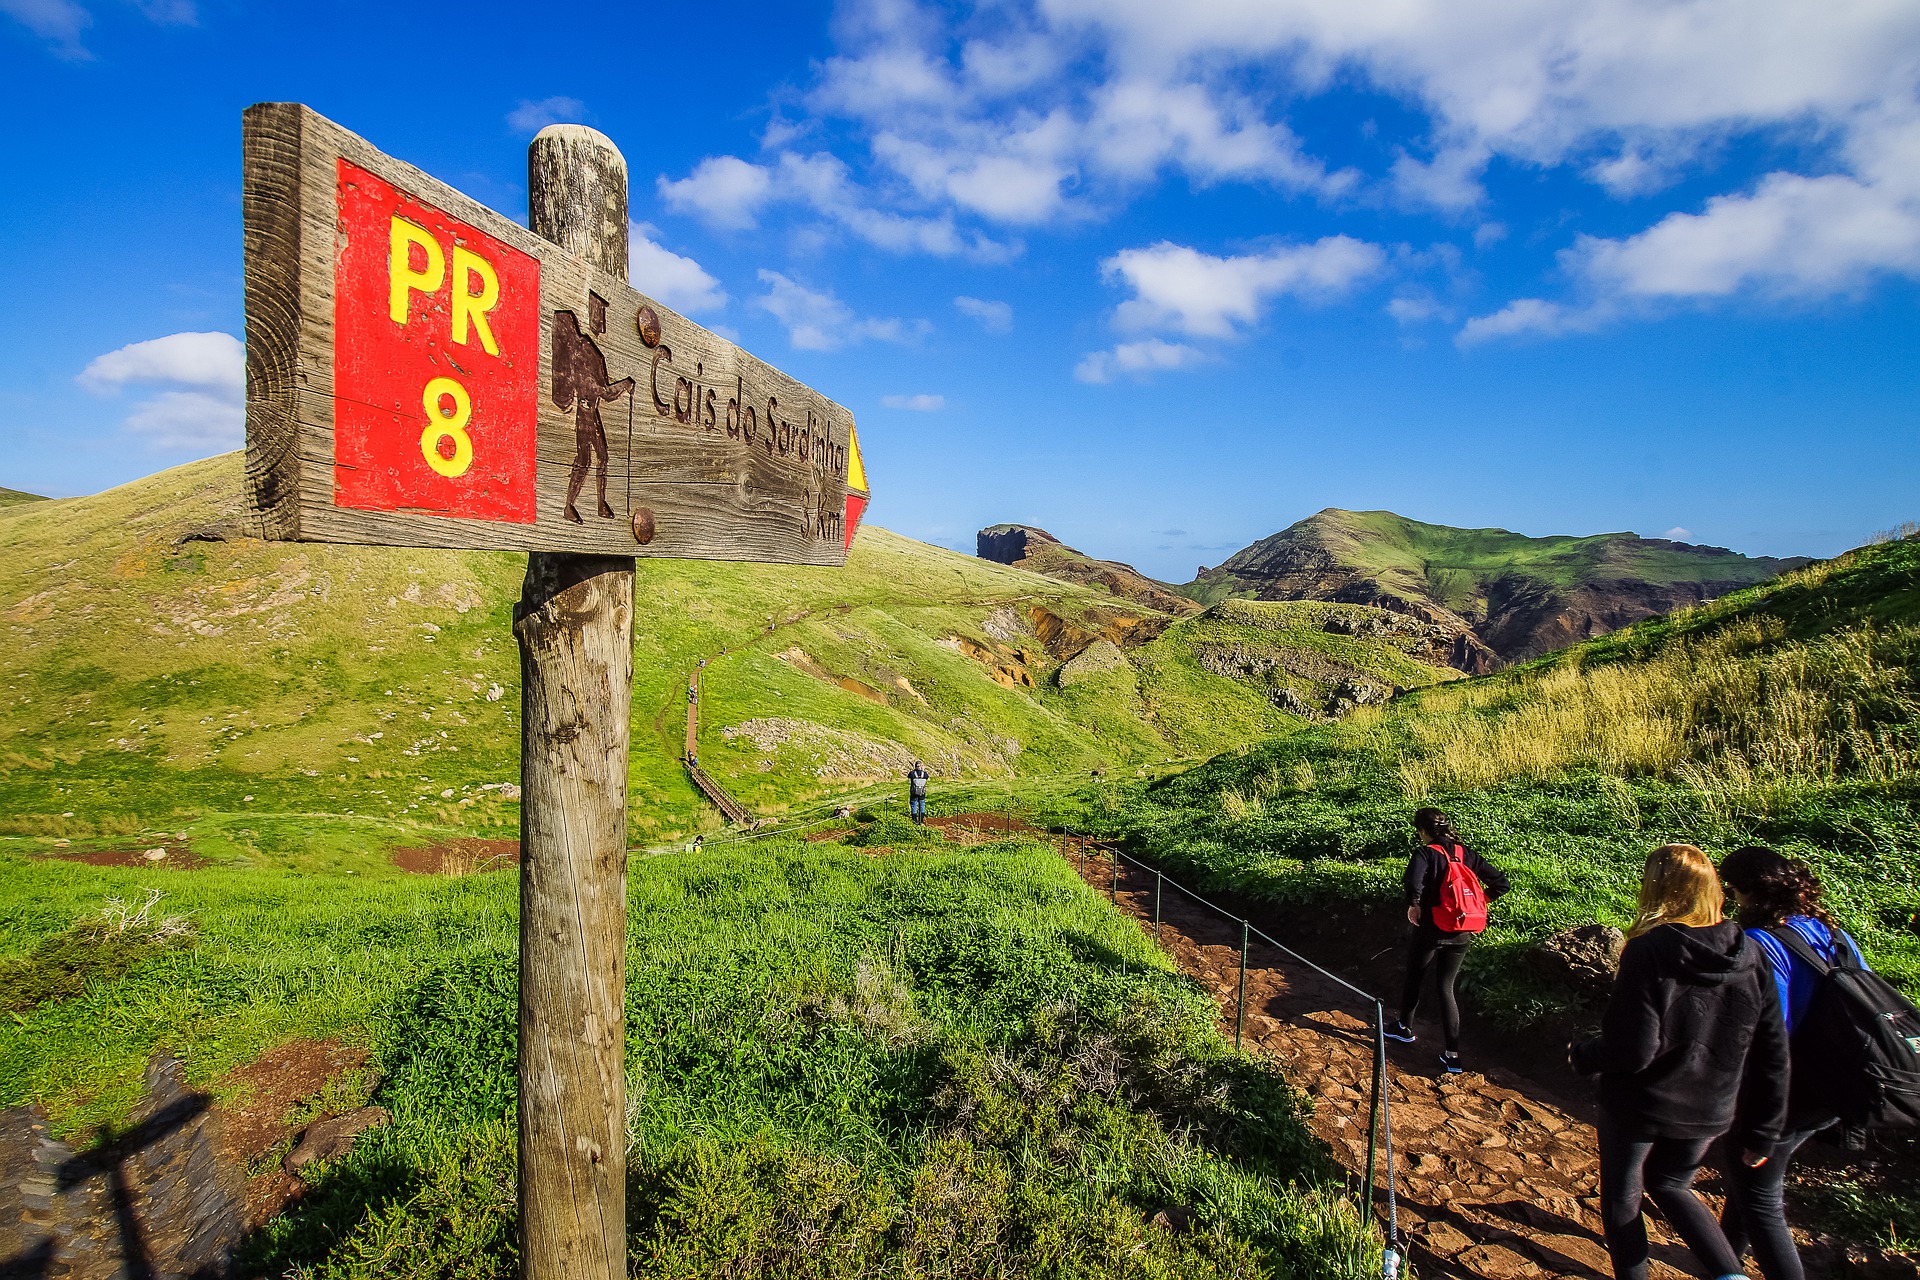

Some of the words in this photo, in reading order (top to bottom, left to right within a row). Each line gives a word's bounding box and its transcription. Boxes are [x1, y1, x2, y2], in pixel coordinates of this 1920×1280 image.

[388, 216, 500, 356] PR
[421, 377, 473, 477] 8
[651, 345, 716, 432] Cais
[726, 376, 757, 446] do
[765, 396, 844, 477] Sardinha
[800, 487, 810, 539] 3
